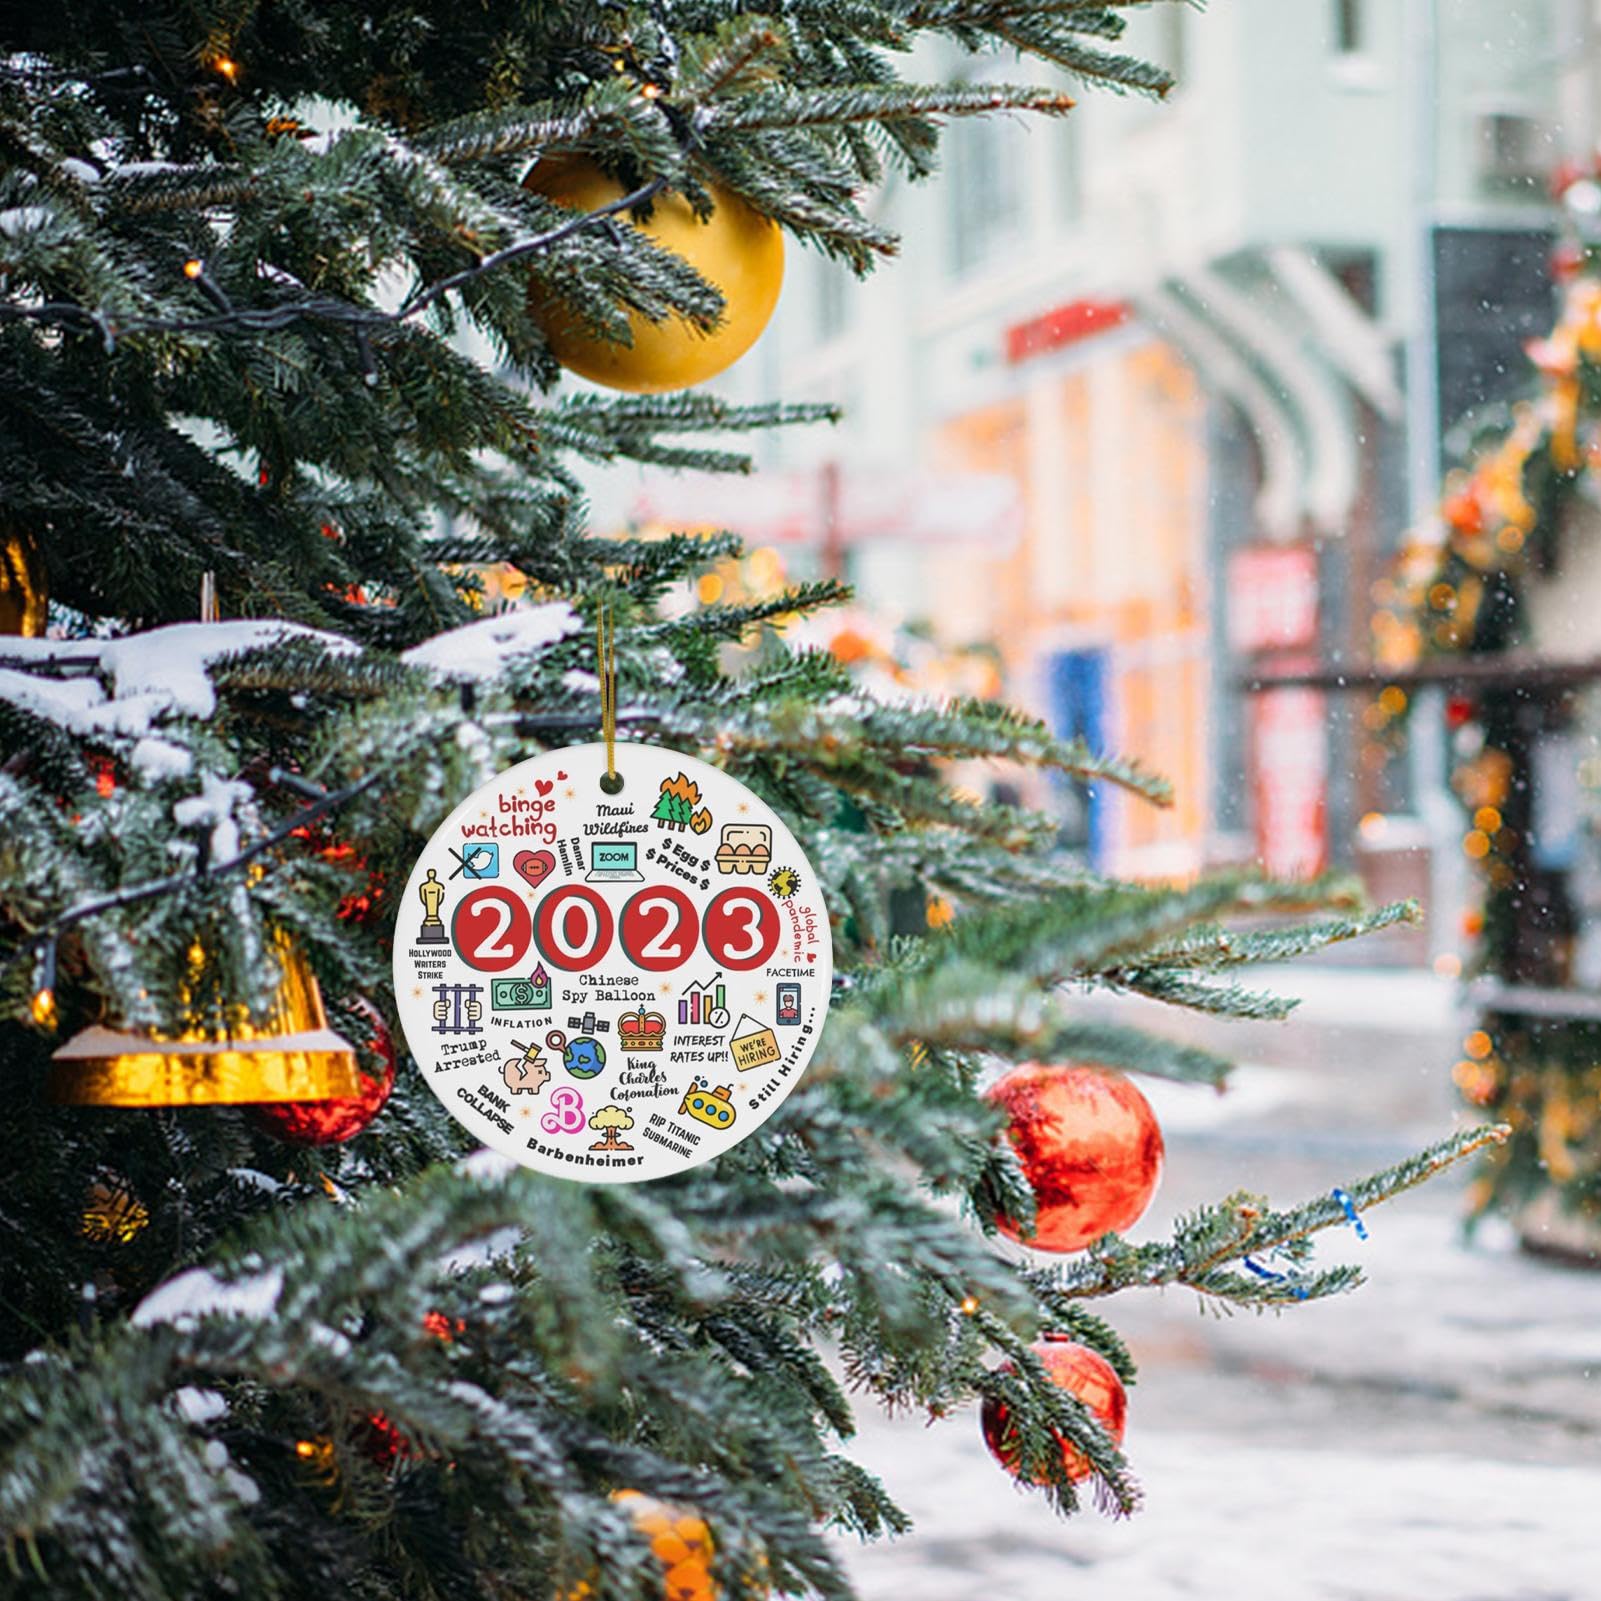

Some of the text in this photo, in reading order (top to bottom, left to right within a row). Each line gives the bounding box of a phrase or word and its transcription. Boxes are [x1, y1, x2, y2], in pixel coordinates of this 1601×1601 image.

[498, 793, 555, 821] binge
[596, 802, 635, 817] Maui
[461, 815, 557, 845] watching
[583, 821, 649, 838] Wildfires
[557, 838, 573, 877] Hamlin
[570, 837, 586, 871] Damar
[599, 852, 629, 862] ZOOM
[672, 843, 699, 867] Egg
[656, 853, 698, 885] Prices
[470, 895, 765, 961] 2023
[781, 900, 805, 963] pandemic
[799, 906, 820, 945] global
[408, 949, 452, 958] HOLLYWOOD
[414, 960, 447, 968] WRITERS
[417, 971, 444, 979] STRIKE
[579, 974, 639, 986] Chinese
[766, 968, 815, 977] FACETIME
[562, 989, 656, 1004] Spy Balloon
[490, 1016, 553, 1029] INFLATION
[440, 1038, 487, 1056] Trump
[673, 1035, 726, 1047] INTEREST
[739, 1037, 767, 1053] WE'RE
[433, 1049, 501, 1073] Arrested
[627, 1056, 657, 1072] King
[670, 1051, 729, 1063] RATES UP!!
[738, 1045, 776, 1066] HIRING
[619, 1070, 668, 1086] Charles
[477, 1084, 511, 1114] BANK
[609, 1082, 680, 1102] Coronation
[748, 1078, 781, 1110] Still
[456, 1087, 515, 1136] COLLAPSE
[540, 1086, 587, 1135] B
[648, 1113, 701, 1146] RIP TITANIC
[526, 1137, 644, 1167] Barbenheimer
[642, 1127, 693, 1159] SUBMARINE
